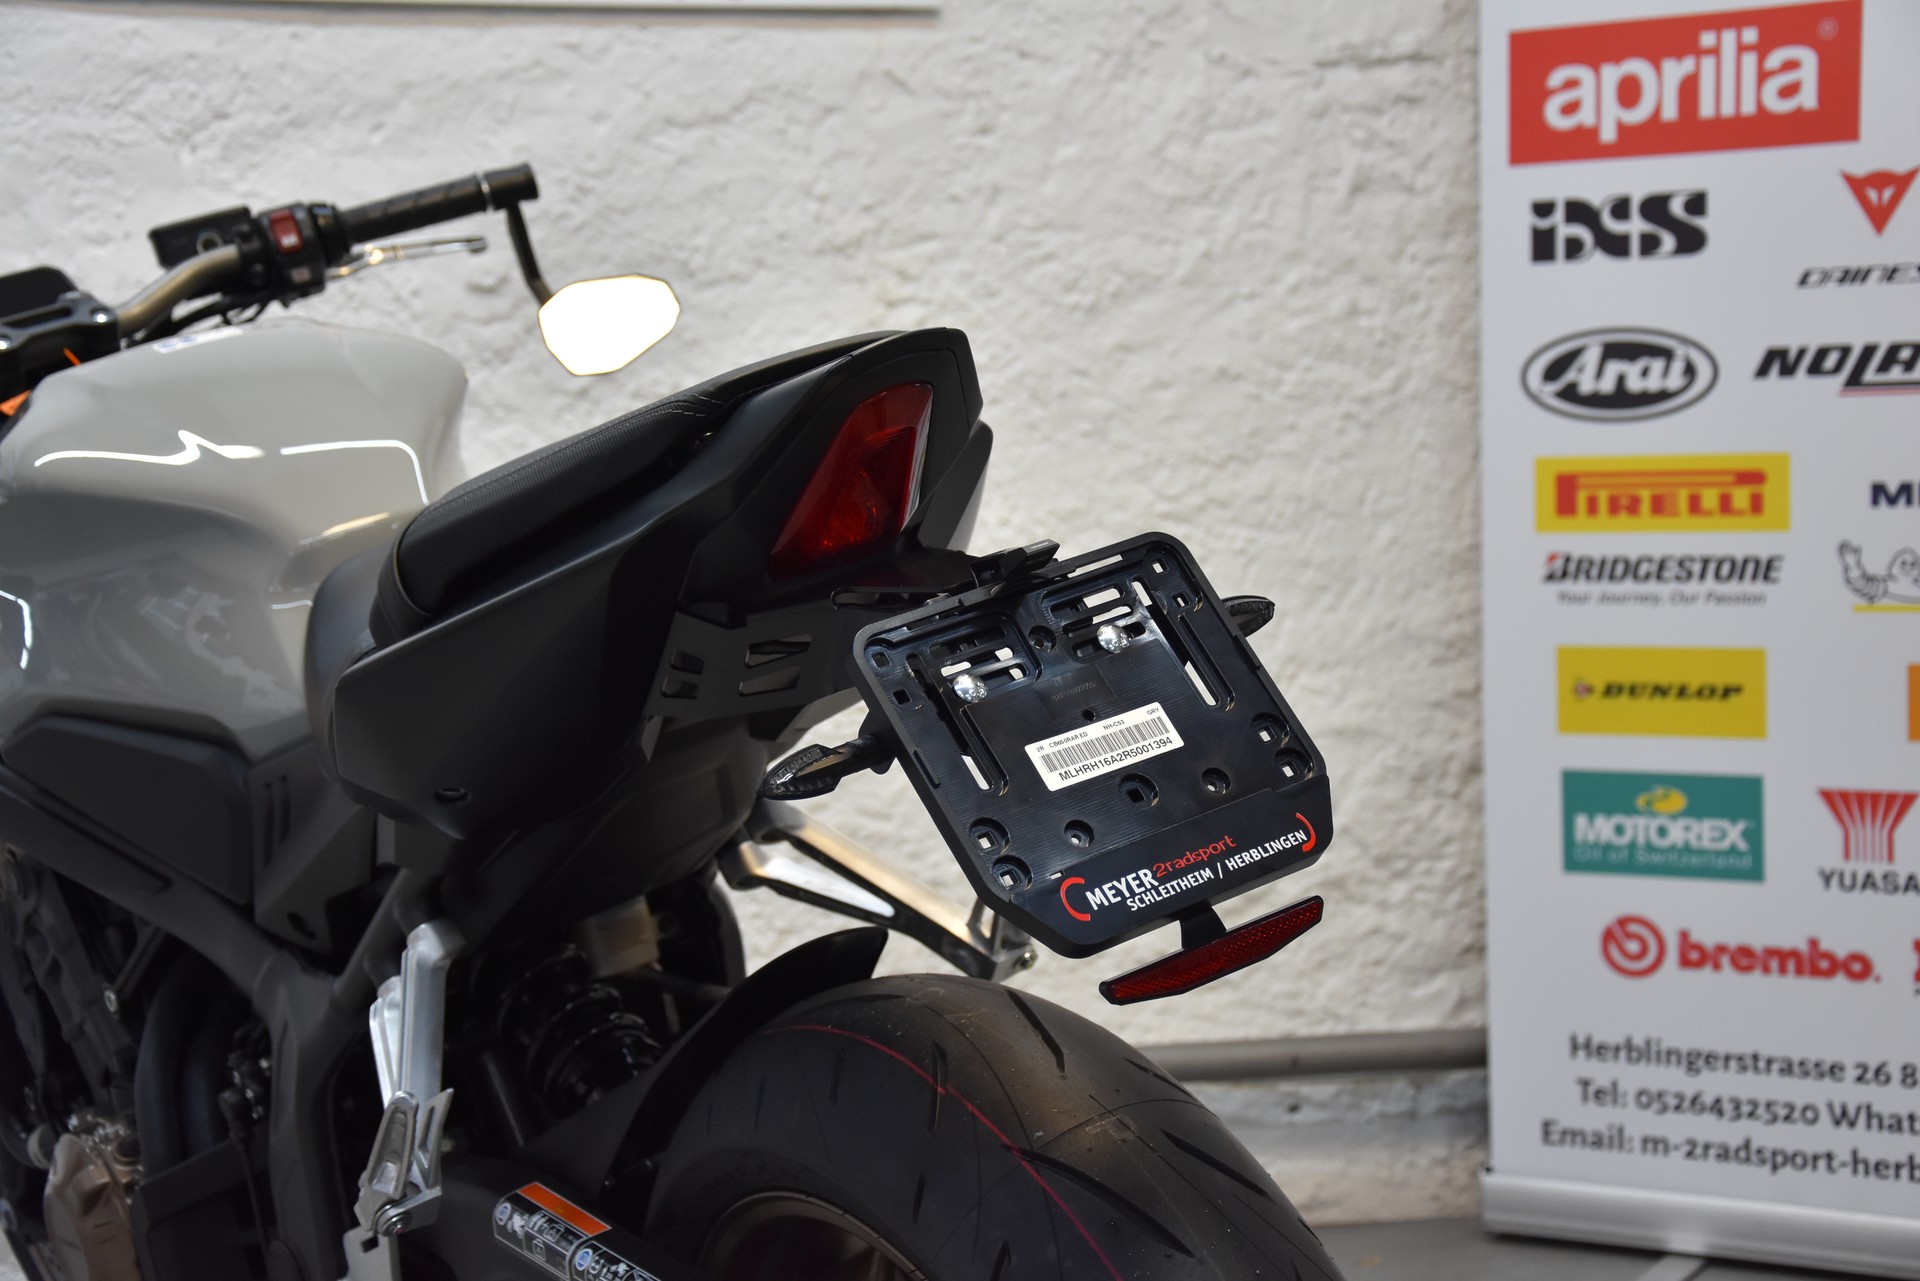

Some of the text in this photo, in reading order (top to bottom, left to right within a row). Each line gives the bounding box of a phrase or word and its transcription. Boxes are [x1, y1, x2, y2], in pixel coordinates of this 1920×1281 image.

[1543, 25, 1820, 145] aprilia
[1538, 339, 1691, 396] Arai
[1555, 469, 1768, 518] PIRELLI
[1544, 552, 1785, 584] BRIDGESTONE
[1556, 590, 1592, 606] Your
[1668, 590, 1699, 606] Our
[1706, 590, 1767, 606] Passion
[1602, 682, 1744, 702] DUNLOP
[1102, 719, 1126, 731] NH-C53
[1058, 736, 1173, 782] MLHRH16A2R5001394
[1573, 813, 1750, 852] MOTOREX
[1085, 835, 1237, 911] MEYER 2radsport
[1126, 867, 1215, 912] SCHLEITHEIM
[1225, 829, 1308, 871] HERBLINGEN
[1573, 848, 1753, 871] Oil of Switzerland
[1818, 867, 1920, 896] YUASA
[1569, 1032, 1846, 1083] Herblingerstrasse
[1853, 1060, 1893, 1088] 26
[1576, 1076, 1628, 1109] Tel:
[1634, 1086, 1820, 1127] 0526432520
[1541, 1118, 1634, 1154] Email:
